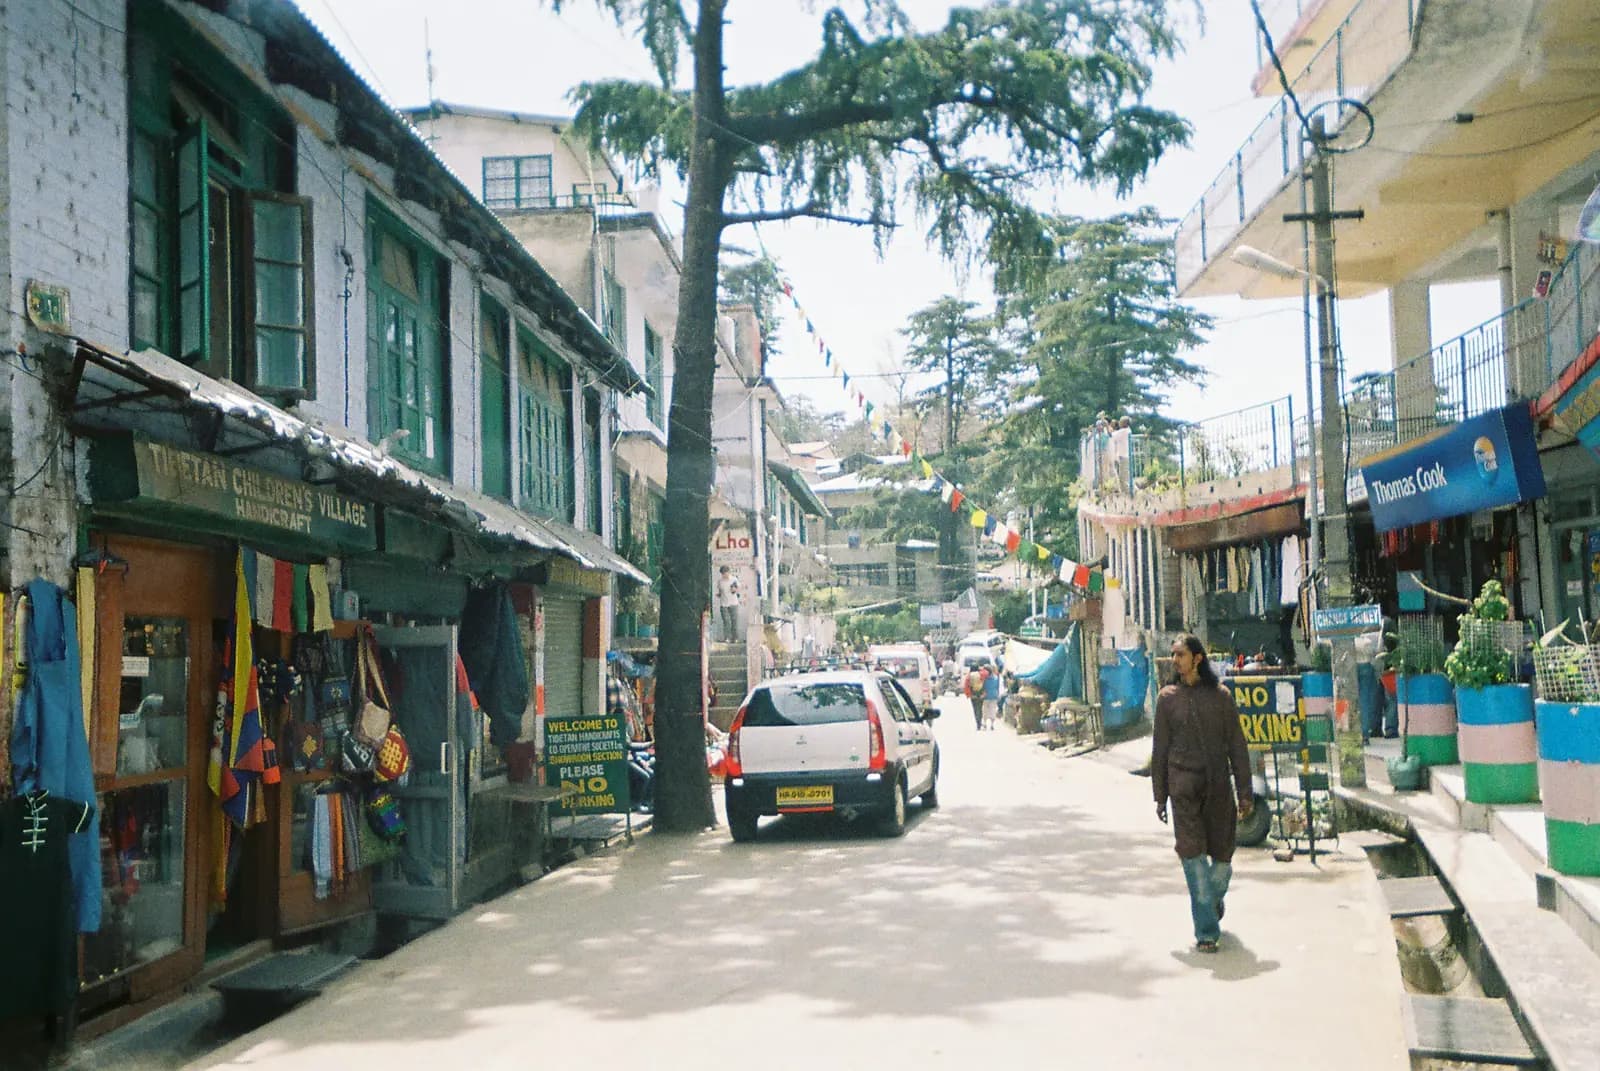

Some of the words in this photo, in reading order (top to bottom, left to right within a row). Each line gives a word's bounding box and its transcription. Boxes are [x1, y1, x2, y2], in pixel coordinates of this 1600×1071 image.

[1372, 475, 1416, 505] Thomas
[1416, 461, 1448, 493] Cook
[232, 467, 313, 513] CHILDREN'S
[318, 492, 368, 529] VILLAGE
[235, 497, 312, 534] HANDICRAFT
[715, 531, 750, 550] Lha
[1234, 686, 1268, 708] NO
[548, 719, 603, 733] WELCOME
[604, 718, 618, 730] TO
[1239, 713, 1301, 742] RKING
[548, 733, 578, 744] TIBETAN
[593, 751, 623, 762] SECTION
[560, 764, 605, 779] PLEASE
[560, 776, 608, 794] NO
